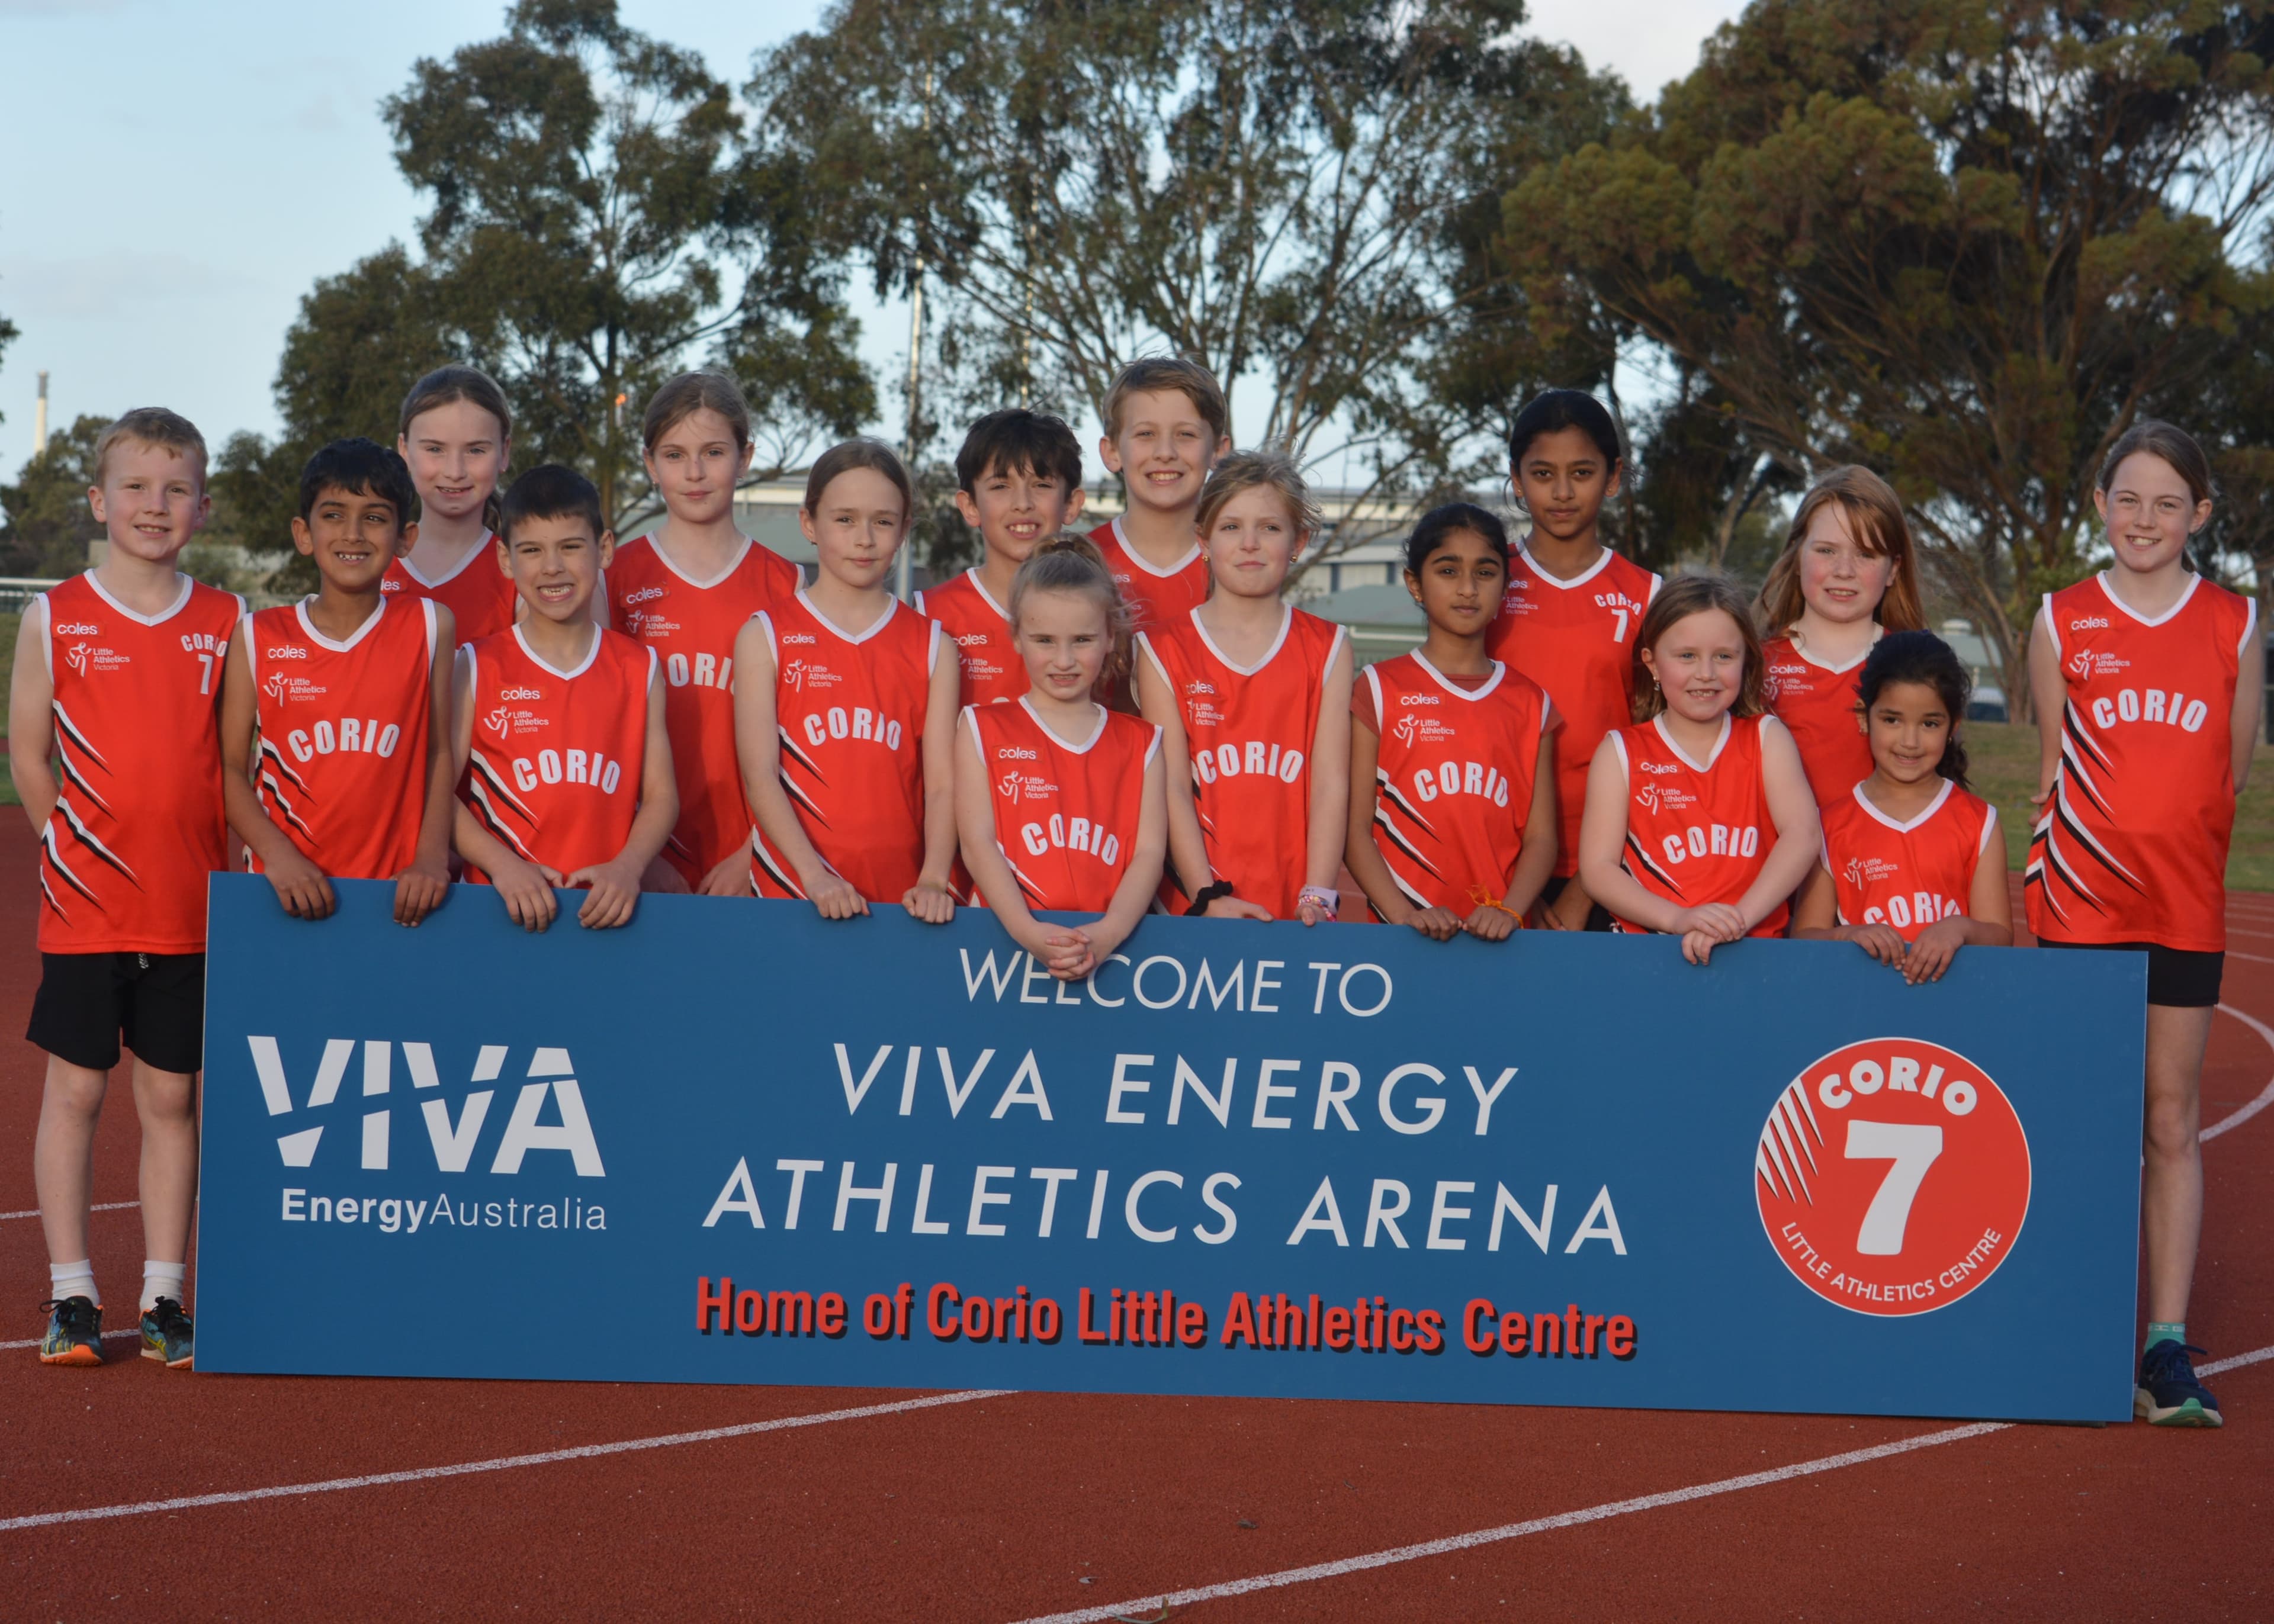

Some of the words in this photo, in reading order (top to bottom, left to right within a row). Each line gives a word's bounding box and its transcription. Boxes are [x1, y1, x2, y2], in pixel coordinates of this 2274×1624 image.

[381, 578, 400, 591] les
[626, 587, 663, 604] coles
[1594, 592, 1642, 616] CORIO
[57, 623, 97, 635] coles
[1611, 609, 1629, 643] 7
[2070, 616, 2108, 629] coles
[180, 633, 227, 657] CORIO
[783, 633, 815, 644] coles
[93, 648, 114, 656] Little
[268, 646, 306, 659] coles
[808, 664, 827, 673] Little
[1769, 664, 1806, 674] coles
[2095, 659, 2130, 667] Athletics
[198, 655, 213, 694] 7
[664, 652, 734, 695] ORI
[808, 673, 842, 681] Athletics
[501, 687, 540, 700] coles
[1401, 693, 1440, 706] coles
[1195, 703, 1214, 712] Little
[2092, 688, 2208, 733] CORIO
[1195, 711, 1225, 721] Athletics
[803, 706, 901, 751] CORIO
[288, 718, 400, 763] CORIO
[998, 747, 1036, 760] coles
[1196, 741, 1303, 784] CORIO
[1640, 761, 1678, 774] coles
[512, 749, 620, 795] CORIO
[1024, 776, 1045, 784] Little
[1024, 783, 1058, 792] Athletics
[1413, 761, 1508, 808] CORIO
[1661, 787, 1681, 796] Little
[1663, 794, 1697, 803] Athletics
[1021, 813, 1119, 866] CORIO
[1662, 824, 1758, 864] CORIO
[1863, 857, 1882, 868] Little
[1865, 863, 1898, 875] Athletics
[959, 947, 1285, 1013] WELCOME
[1309, 962, 1393, 1017] TO
[834, 1043, 1054, 1121] VIVA
[1105, 1053, 1519, 1136] ENERGY
[1819, 1056, 1977, 1116] CORIO
[247, 1035, 606, 1177] VIVA
[1844, 1119, 1943, 1256] 7
[702, 1155, 1242, 1244] ATHLETICS
[1286, 1175, 1628, 1256] ARENA
[1781, 1221, 1832, 1280] LITTLE
[1830, 1272, 1936, 1302] ATHLETICS
[1938, 1227, 2002, 1288] CENTRE
[696, 1275, 847, 1338] Home
[863, 1282, 914, 1340] of
[926, 1282, 1062, 1344] Corio
[1077, 1287, 1207, 1350] Little
[1220, 1291, 1445, 1355] Athletics
[1463, 1297, 1637, 1360] Centre
